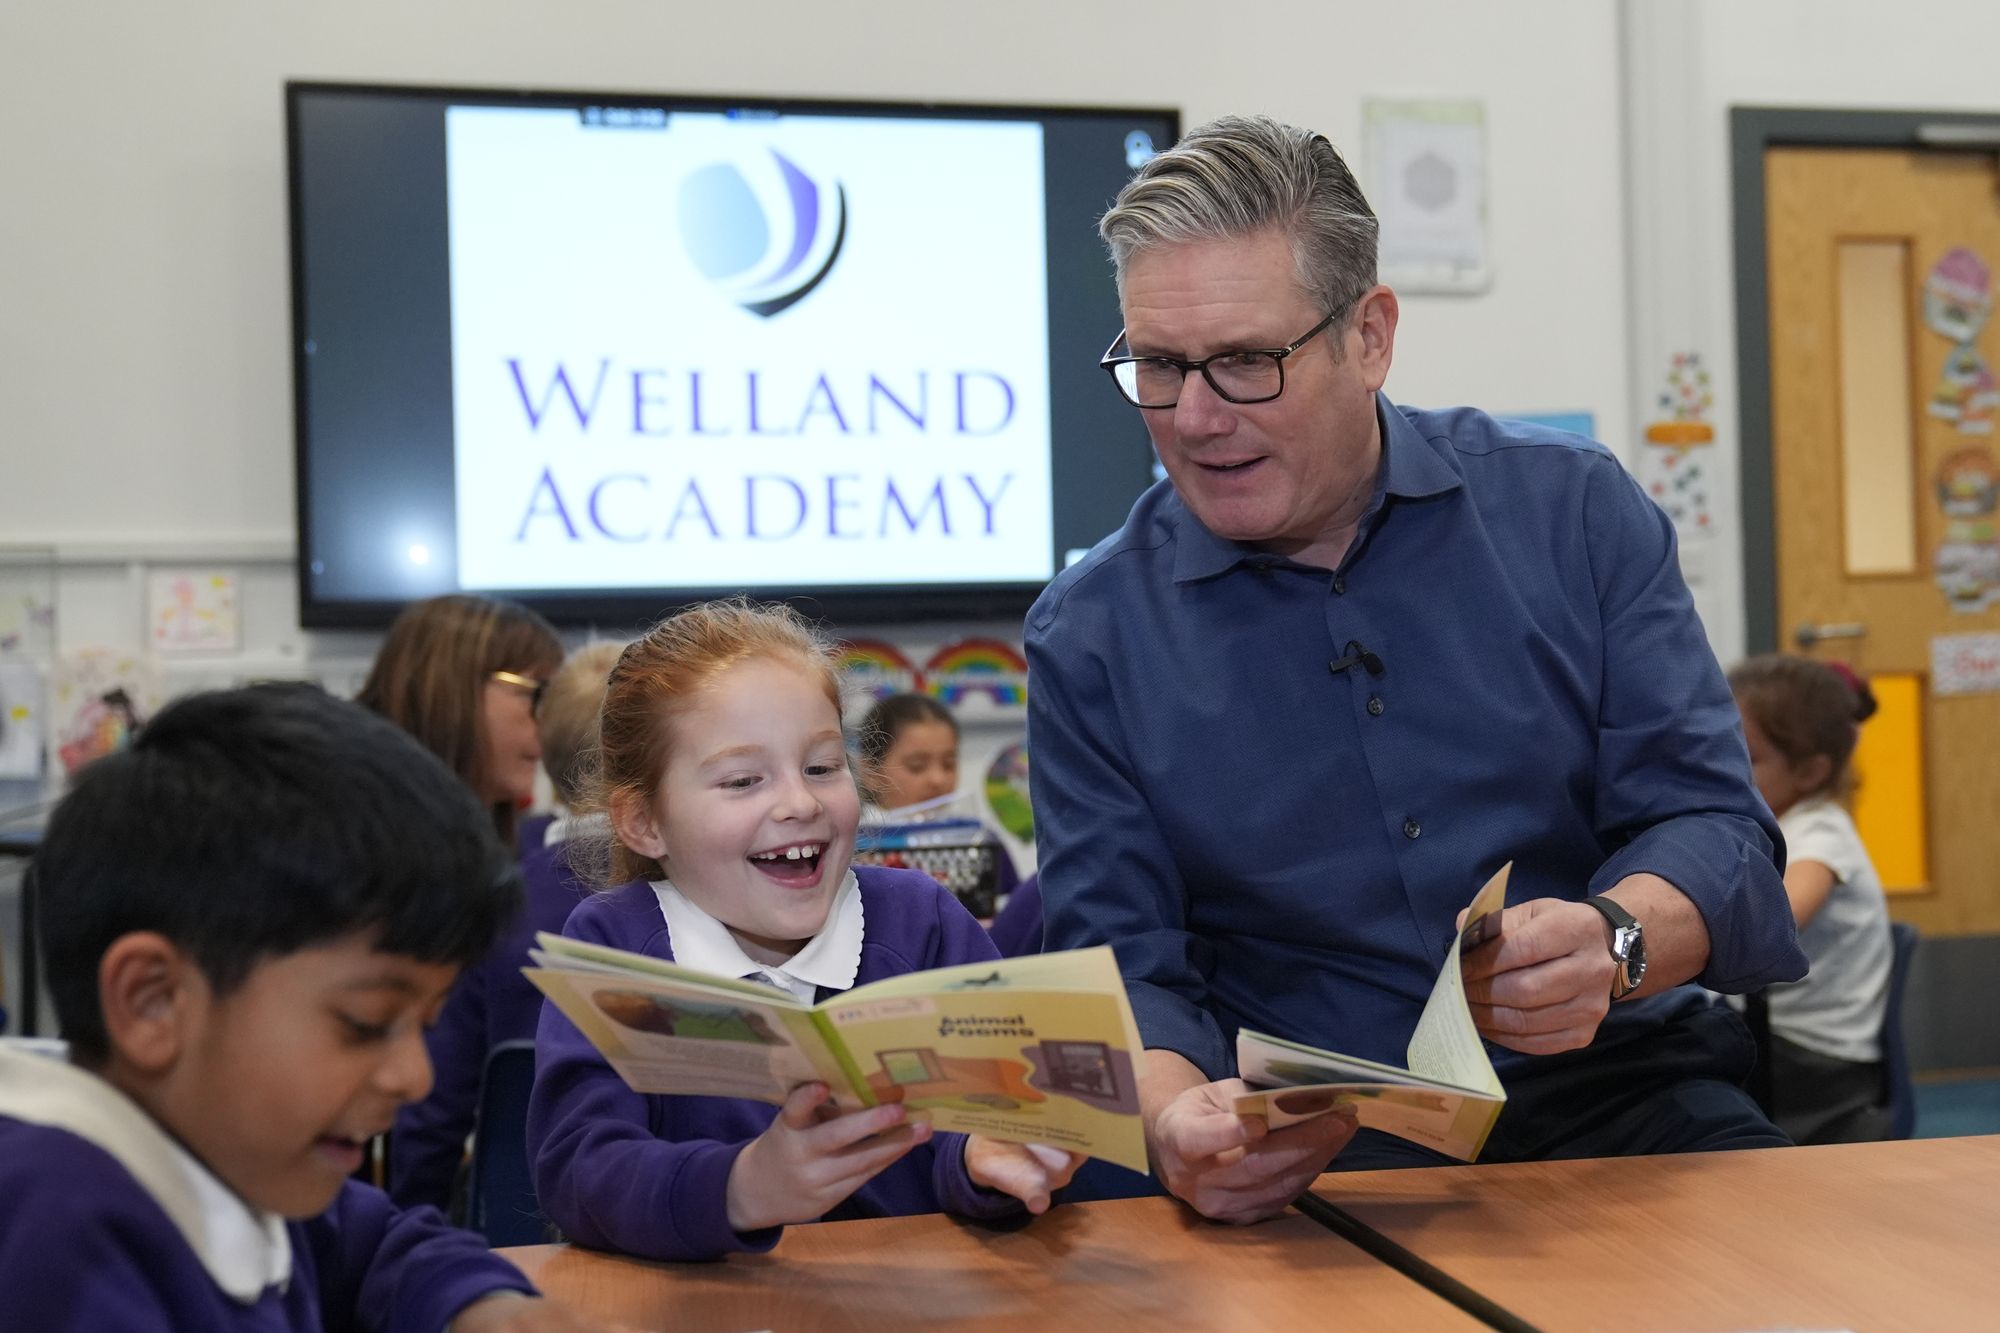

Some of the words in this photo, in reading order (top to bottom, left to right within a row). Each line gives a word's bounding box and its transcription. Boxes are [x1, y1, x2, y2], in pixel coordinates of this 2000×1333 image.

[505, 357, 1018, 436] WELLAND
[513, 464, 1014, 543] ACADEMY
[938, 1025, 1035, 1038] Poems
[941, 1014, 1025, 1026] Animal
